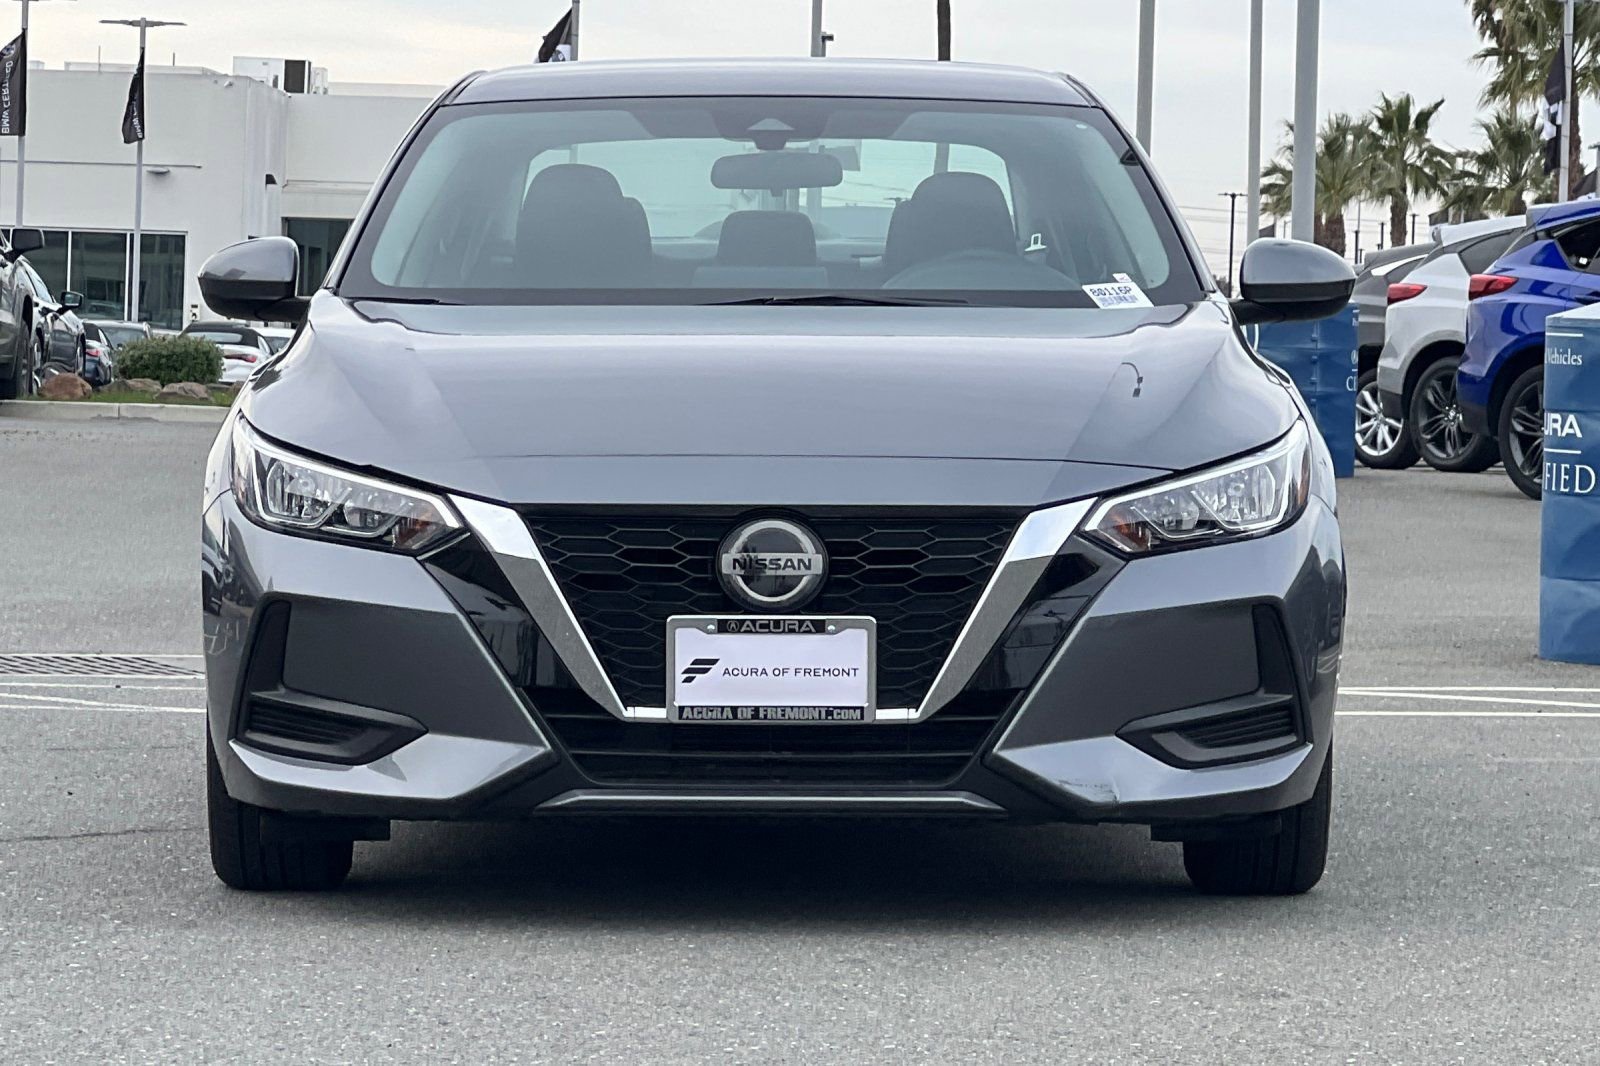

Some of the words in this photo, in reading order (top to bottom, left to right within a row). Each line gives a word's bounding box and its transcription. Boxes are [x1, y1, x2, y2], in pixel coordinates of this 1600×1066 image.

[732, 558, 812, 571] NISSAN
[740, 620, 816, 633] ACURA
[722, 667, 769, 677] ACURA
[772, 667, 790, 677] OF
[794, 667, 860, 677] FREMONT
[737, 707, 755, 720] OF
